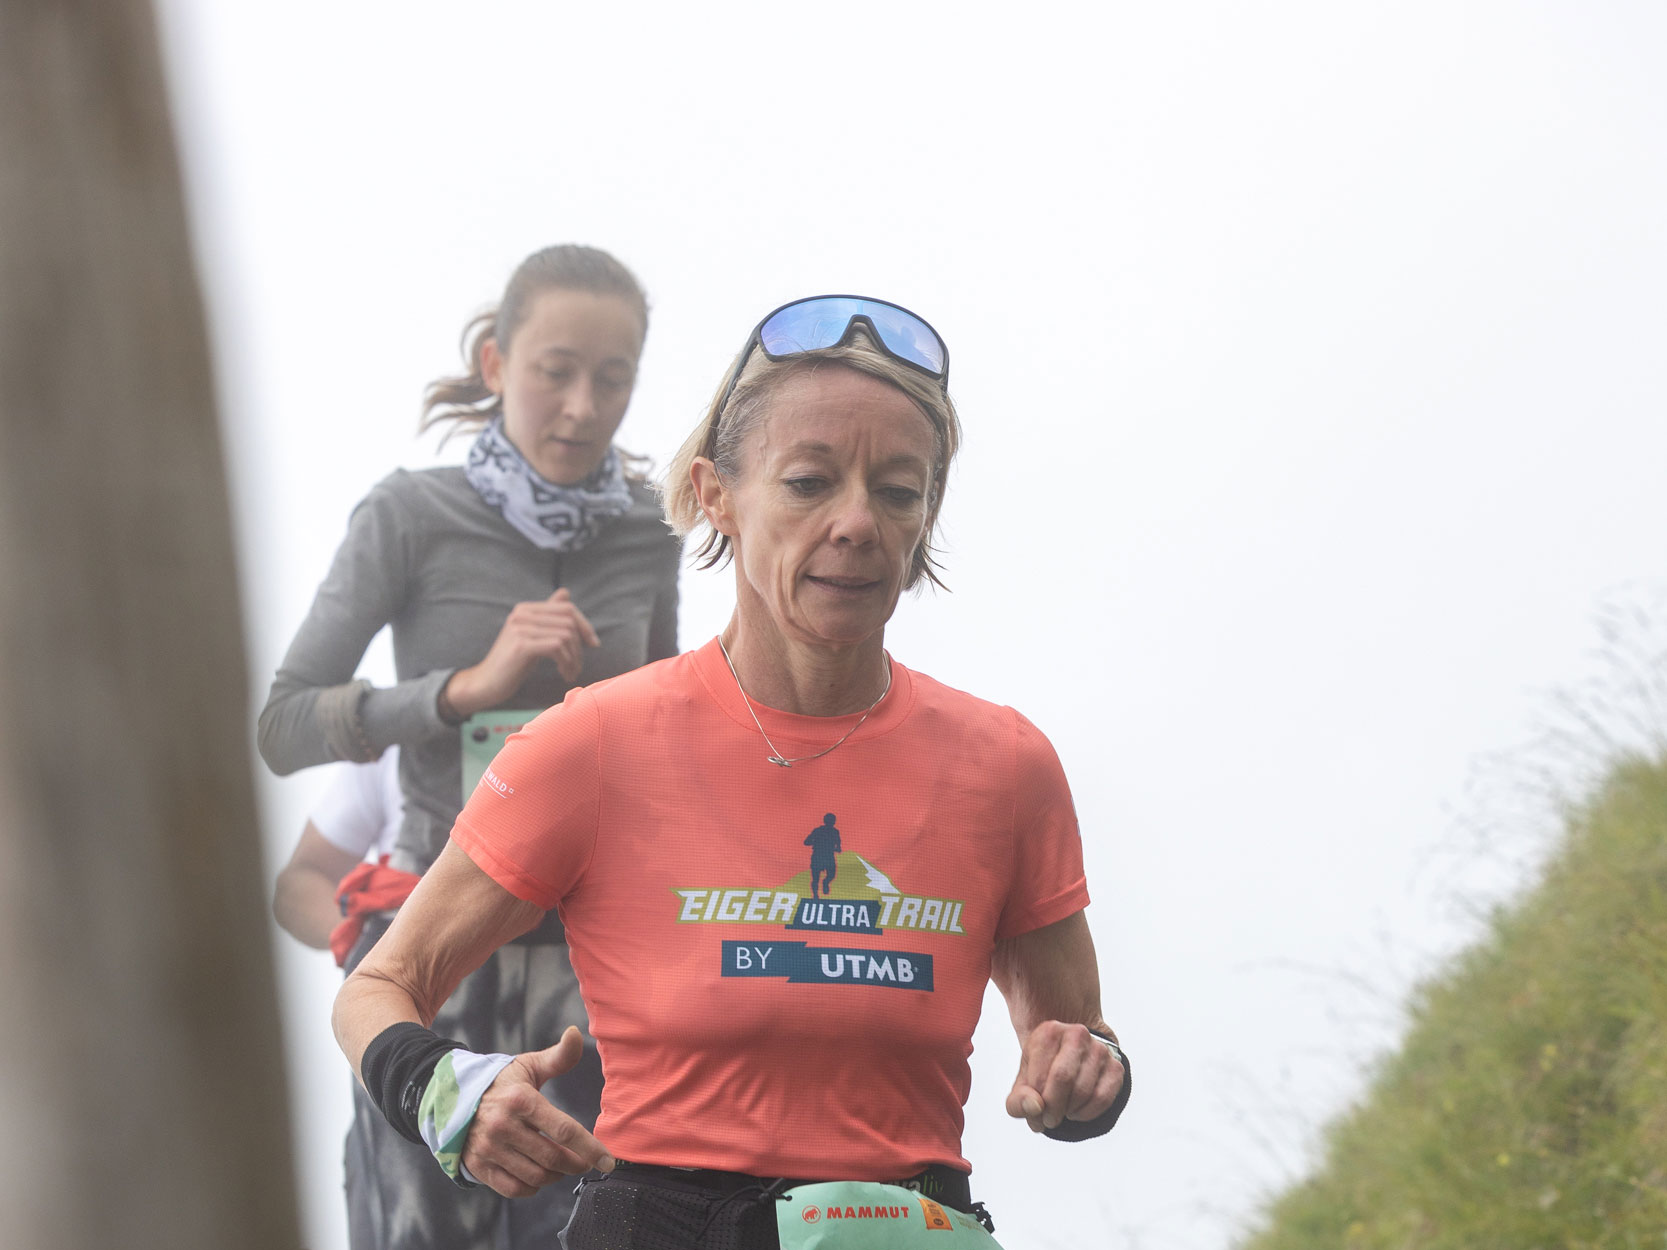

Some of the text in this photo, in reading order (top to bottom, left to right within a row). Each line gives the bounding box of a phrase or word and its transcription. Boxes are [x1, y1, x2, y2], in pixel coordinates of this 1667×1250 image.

[676, 890, 964, 934] EIGER ULTRA TRAIL
[736, 947, 773, 970] BY
[826, 1206, 910, 1220] MAMMUT
